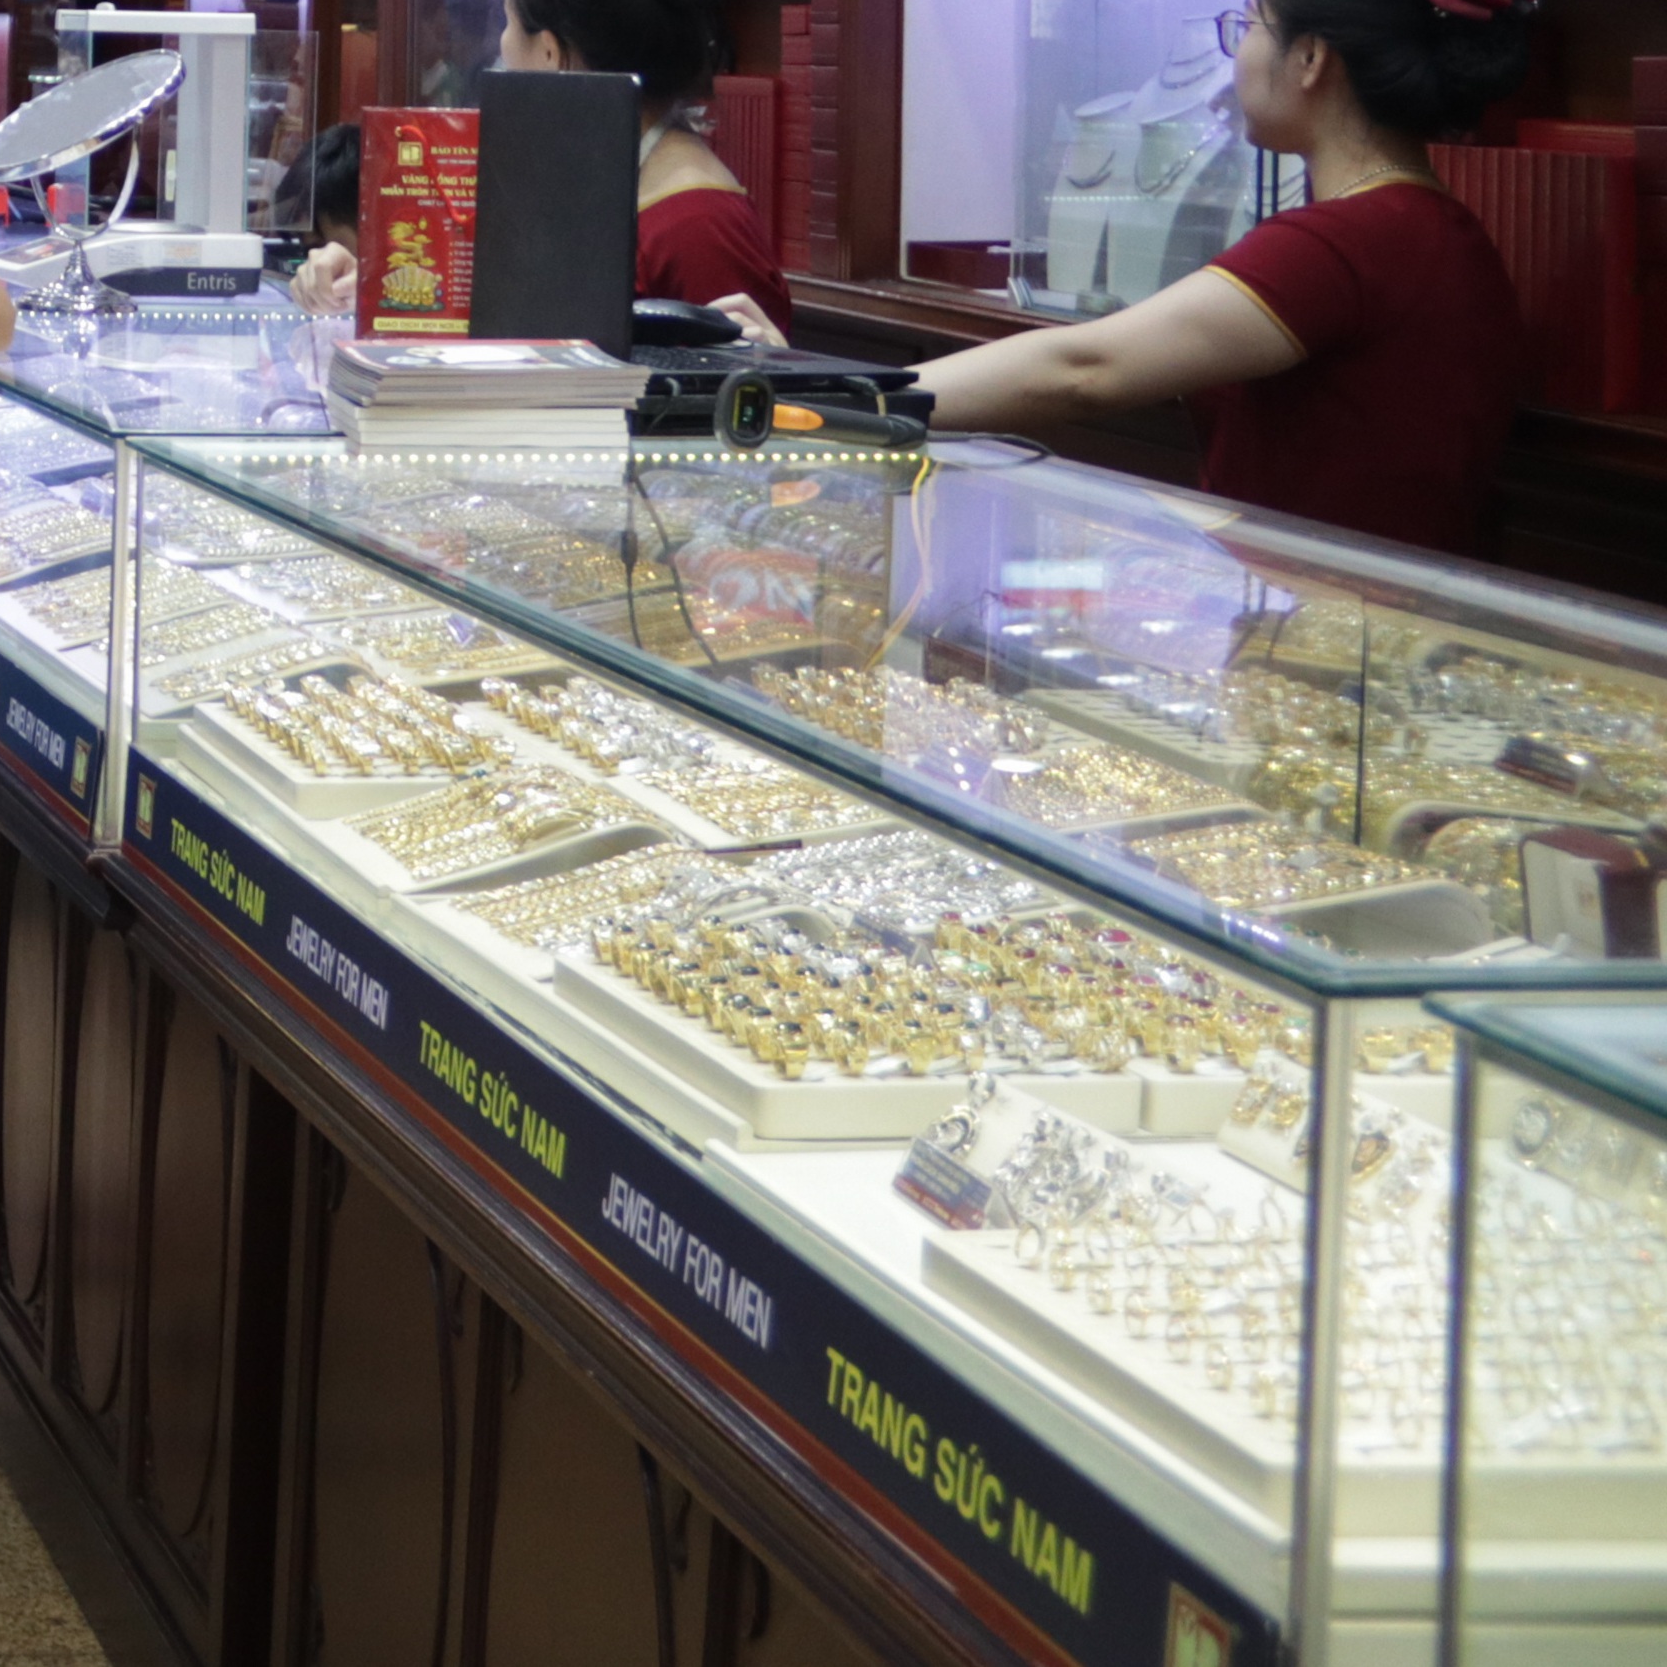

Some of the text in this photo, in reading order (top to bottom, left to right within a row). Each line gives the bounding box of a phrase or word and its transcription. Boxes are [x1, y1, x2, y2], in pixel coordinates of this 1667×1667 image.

[401, 174, 429, 184] VÀNG
[431, 144, 469, 155] BẢO TÍN
[187, 271, 236, 290] Entris
[6, 697, 66, 770] JEWELRY FOR MEN
[171, 818, 265, 926] TRANG SỨC NAM
[286, 914, 389, 1031] JEWELRY FOR MEN
[420, 1020, 567, 1180] TRANG SỨC NAM
[602, 1172, 772, 1350] JEWELRY FOR MEN
[826, 1346, 1095, 1615] TRANG SỨC NAM
